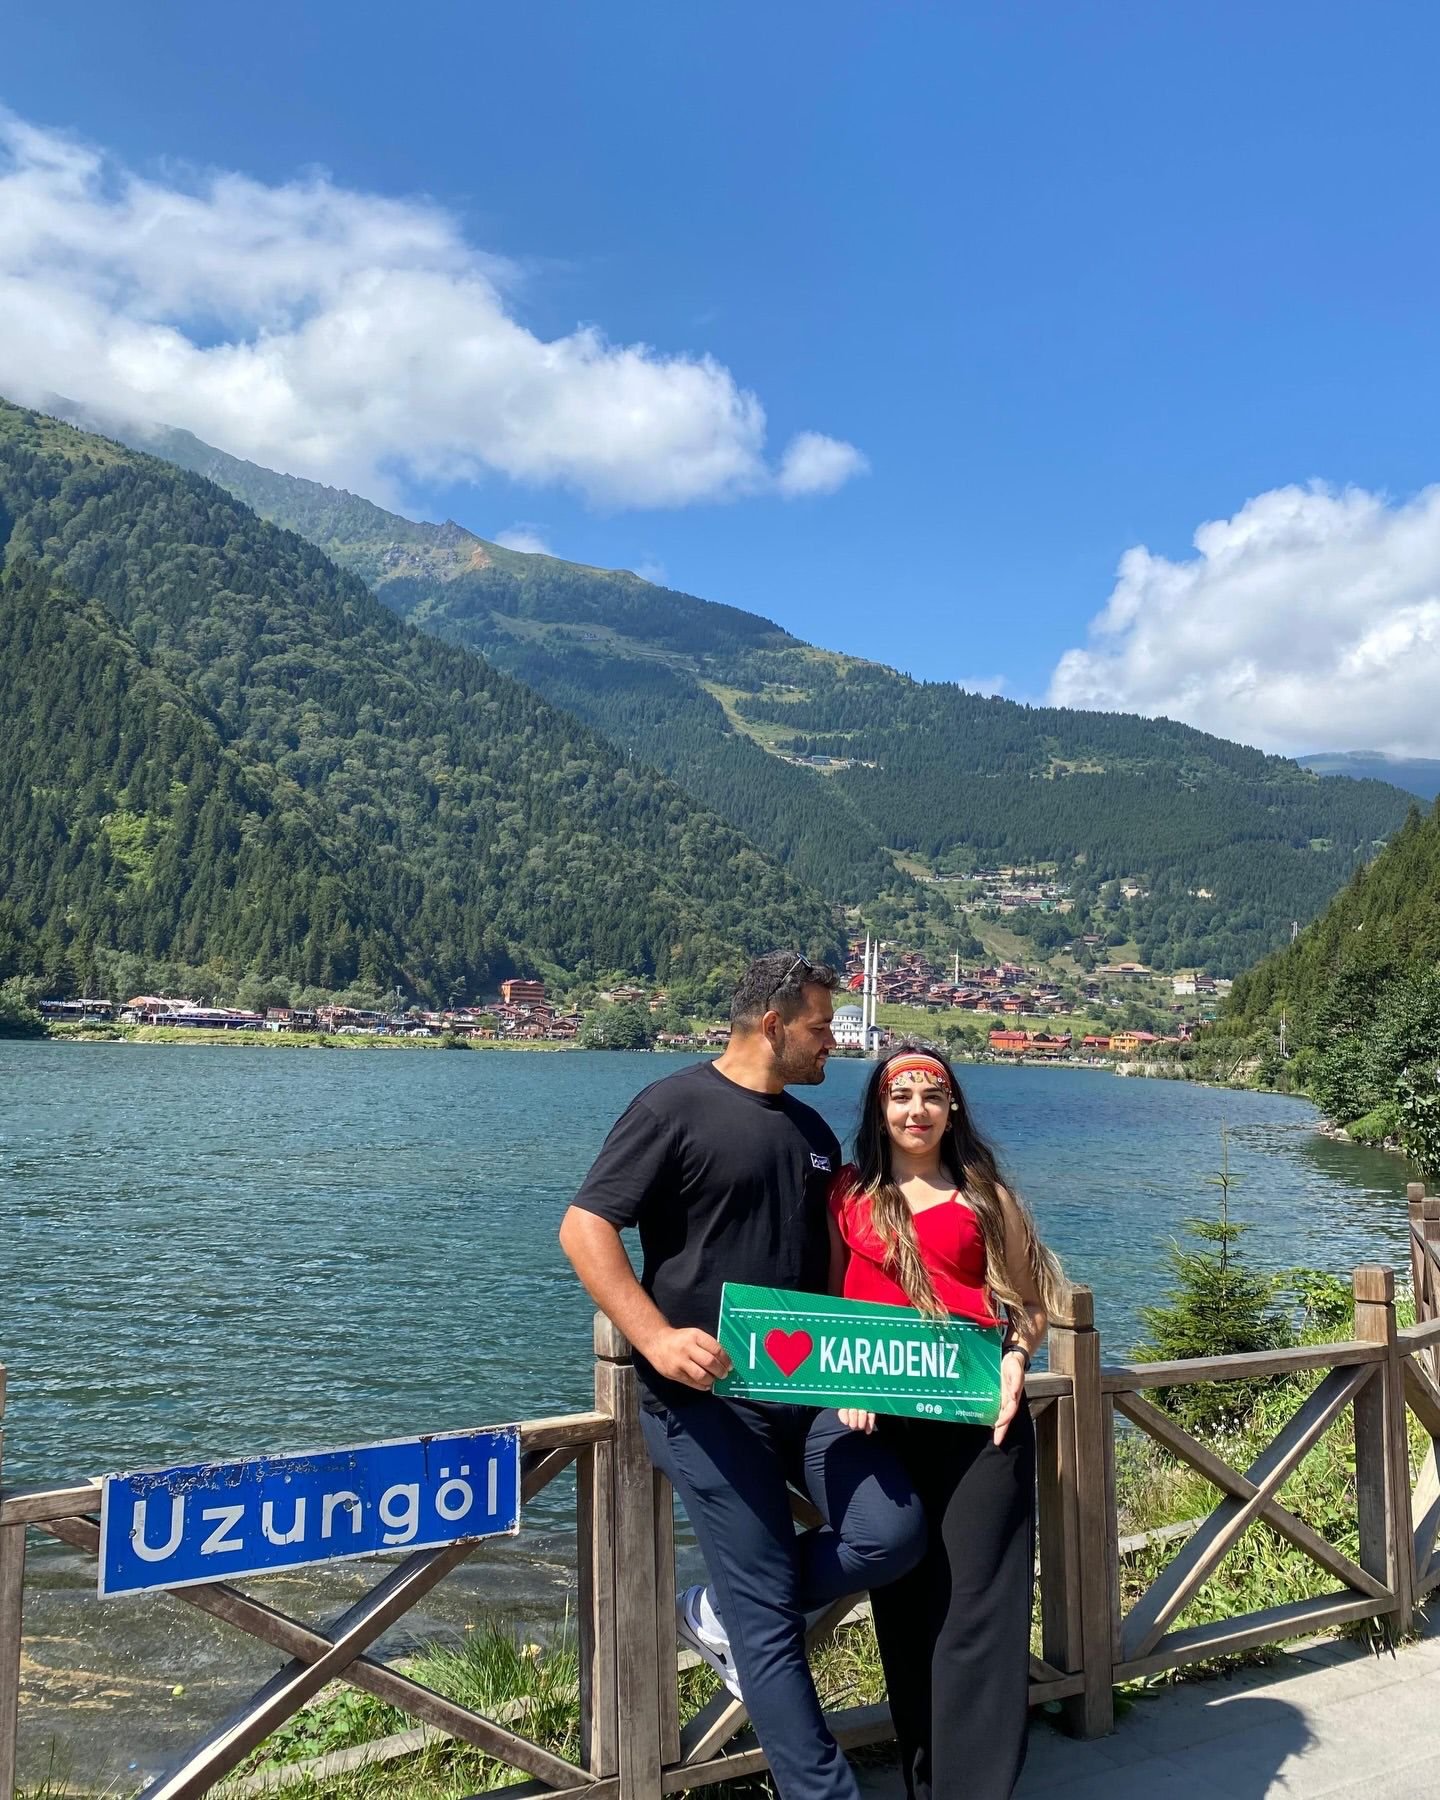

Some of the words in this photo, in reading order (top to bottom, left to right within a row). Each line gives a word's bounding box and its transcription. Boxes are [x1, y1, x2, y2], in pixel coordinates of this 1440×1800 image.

[749, 1332, 756, 1370] I
[819, 1335, 960, 1379] KARADENİZ
[132, 1458, 498, 1562] Uzungöl
